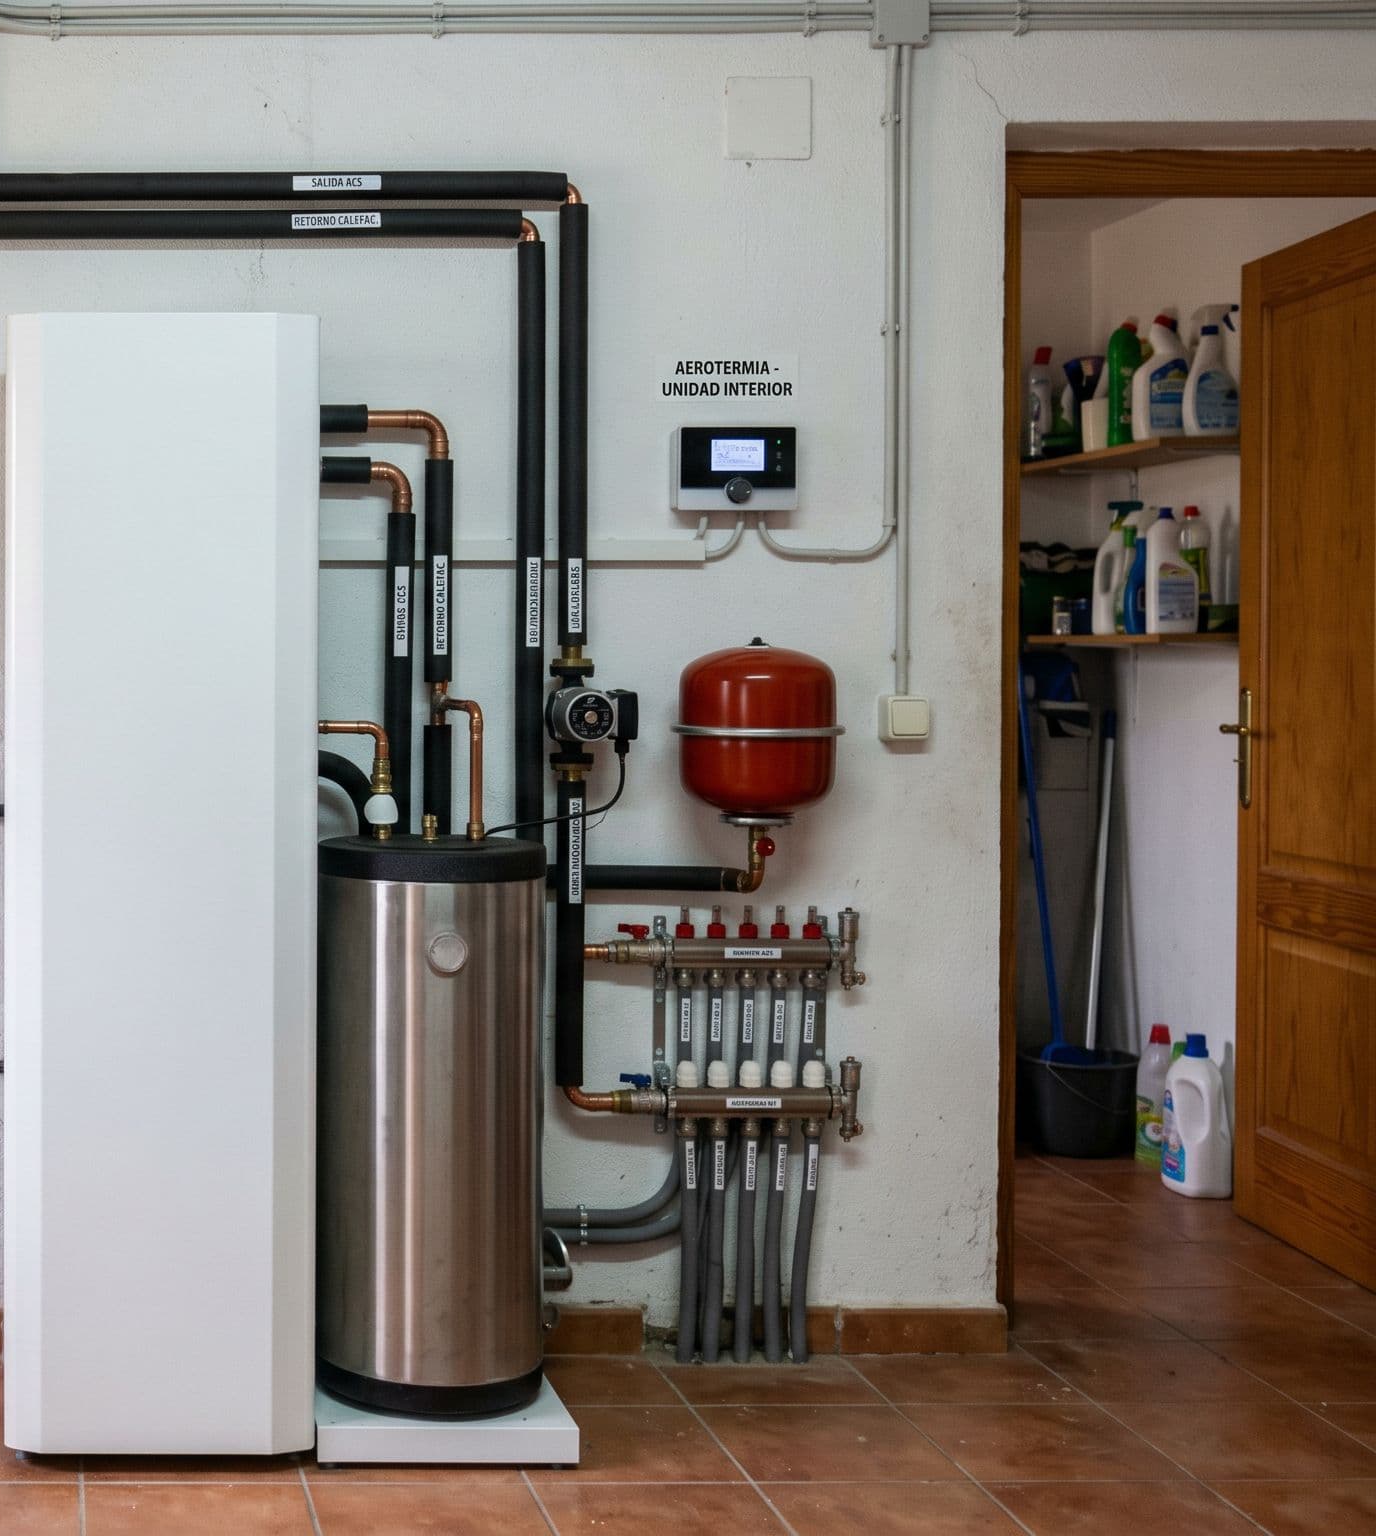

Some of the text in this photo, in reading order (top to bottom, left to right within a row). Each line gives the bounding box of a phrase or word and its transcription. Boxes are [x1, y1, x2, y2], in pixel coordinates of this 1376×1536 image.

[311, 177, 362, 187] SALIDA ACS
[294, 216, 336, 226] RETORNO
[675, 360, 770, 375] AEROTERMIA
[662, 382, 793, 396] UNIDAD INTERIOR
